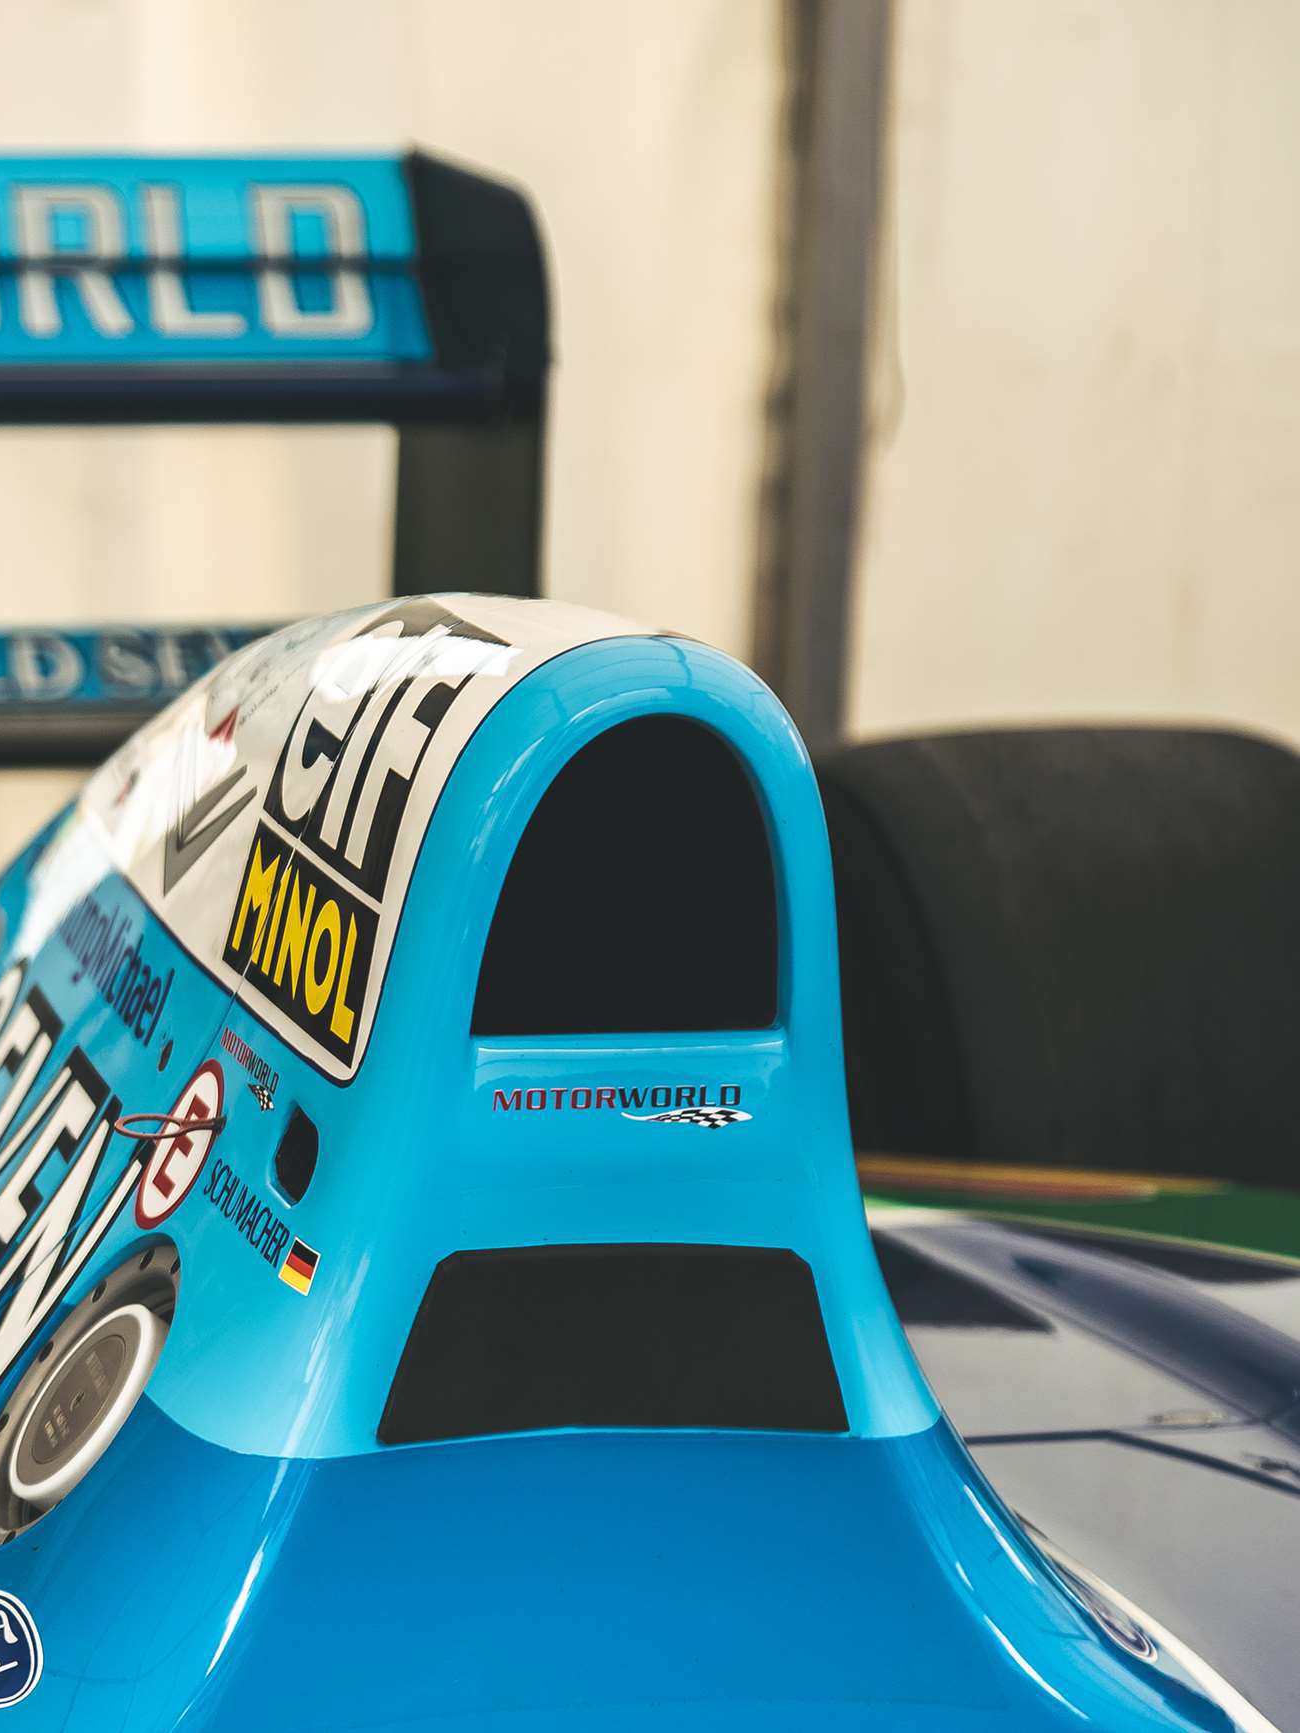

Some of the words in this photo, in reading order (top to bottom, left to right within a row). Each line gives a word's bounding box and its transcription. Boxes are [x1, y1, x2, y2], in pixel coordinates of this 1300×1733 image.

[232, 838, 357, 1044] MINOL
[220, 1024, 280, 1095] MOTORWORLD
[492, 1083, 742, 1112] MOTORWORLD
[152, 1094, 211, 1199] E
[203, 1157, 290, 1268] SCHUMACHER
